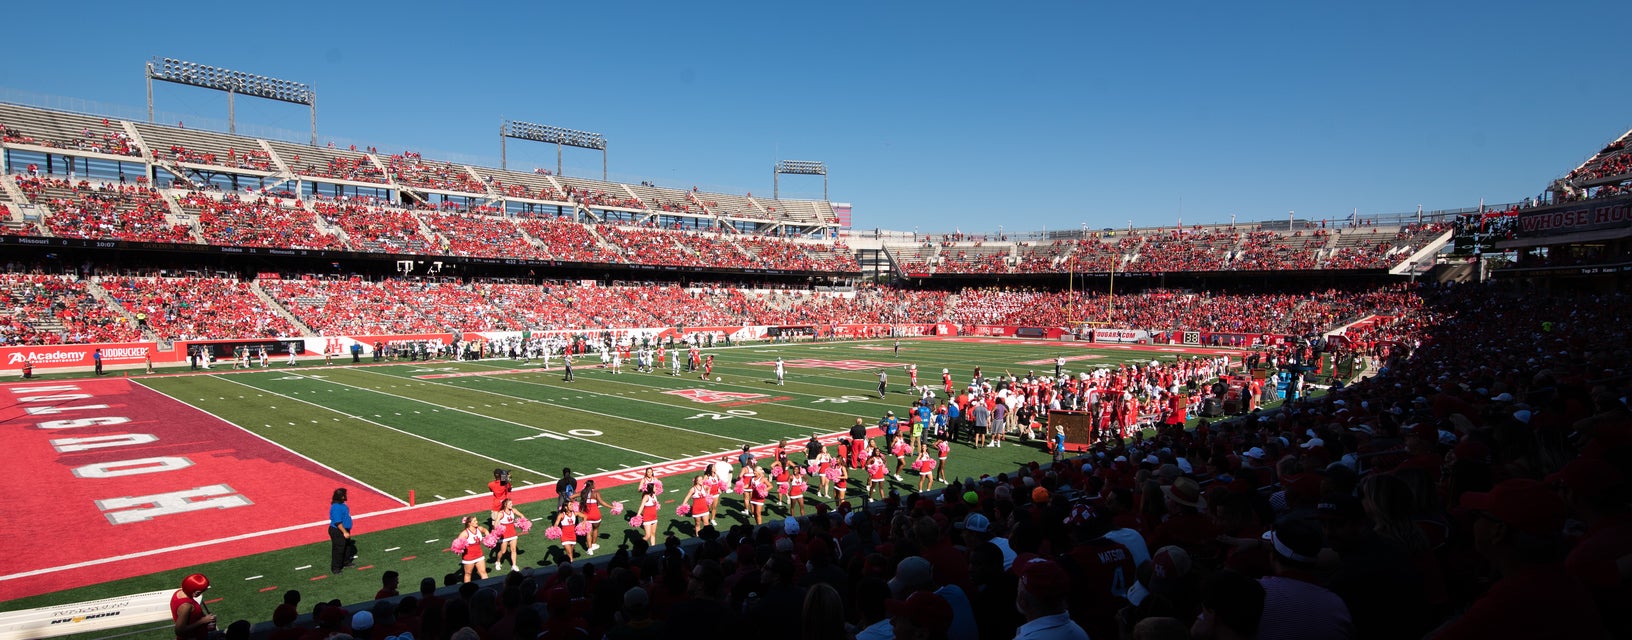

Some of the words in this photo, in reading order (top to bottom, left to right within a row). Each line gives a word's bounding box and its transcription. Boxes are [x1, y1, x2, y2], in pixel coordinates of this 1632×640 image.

[1522, 209, 1588, 232] WHOSE
[18, 237, 49, 245] Missouri
[1185, 333, 1199, 342] 38
[27, 351, 85, 361] Academy
[100, 347, 149, 358] UDDRUCKER
[684, 409, 758, 421] 20
[8, 384, 255, 526] HOUSTON
